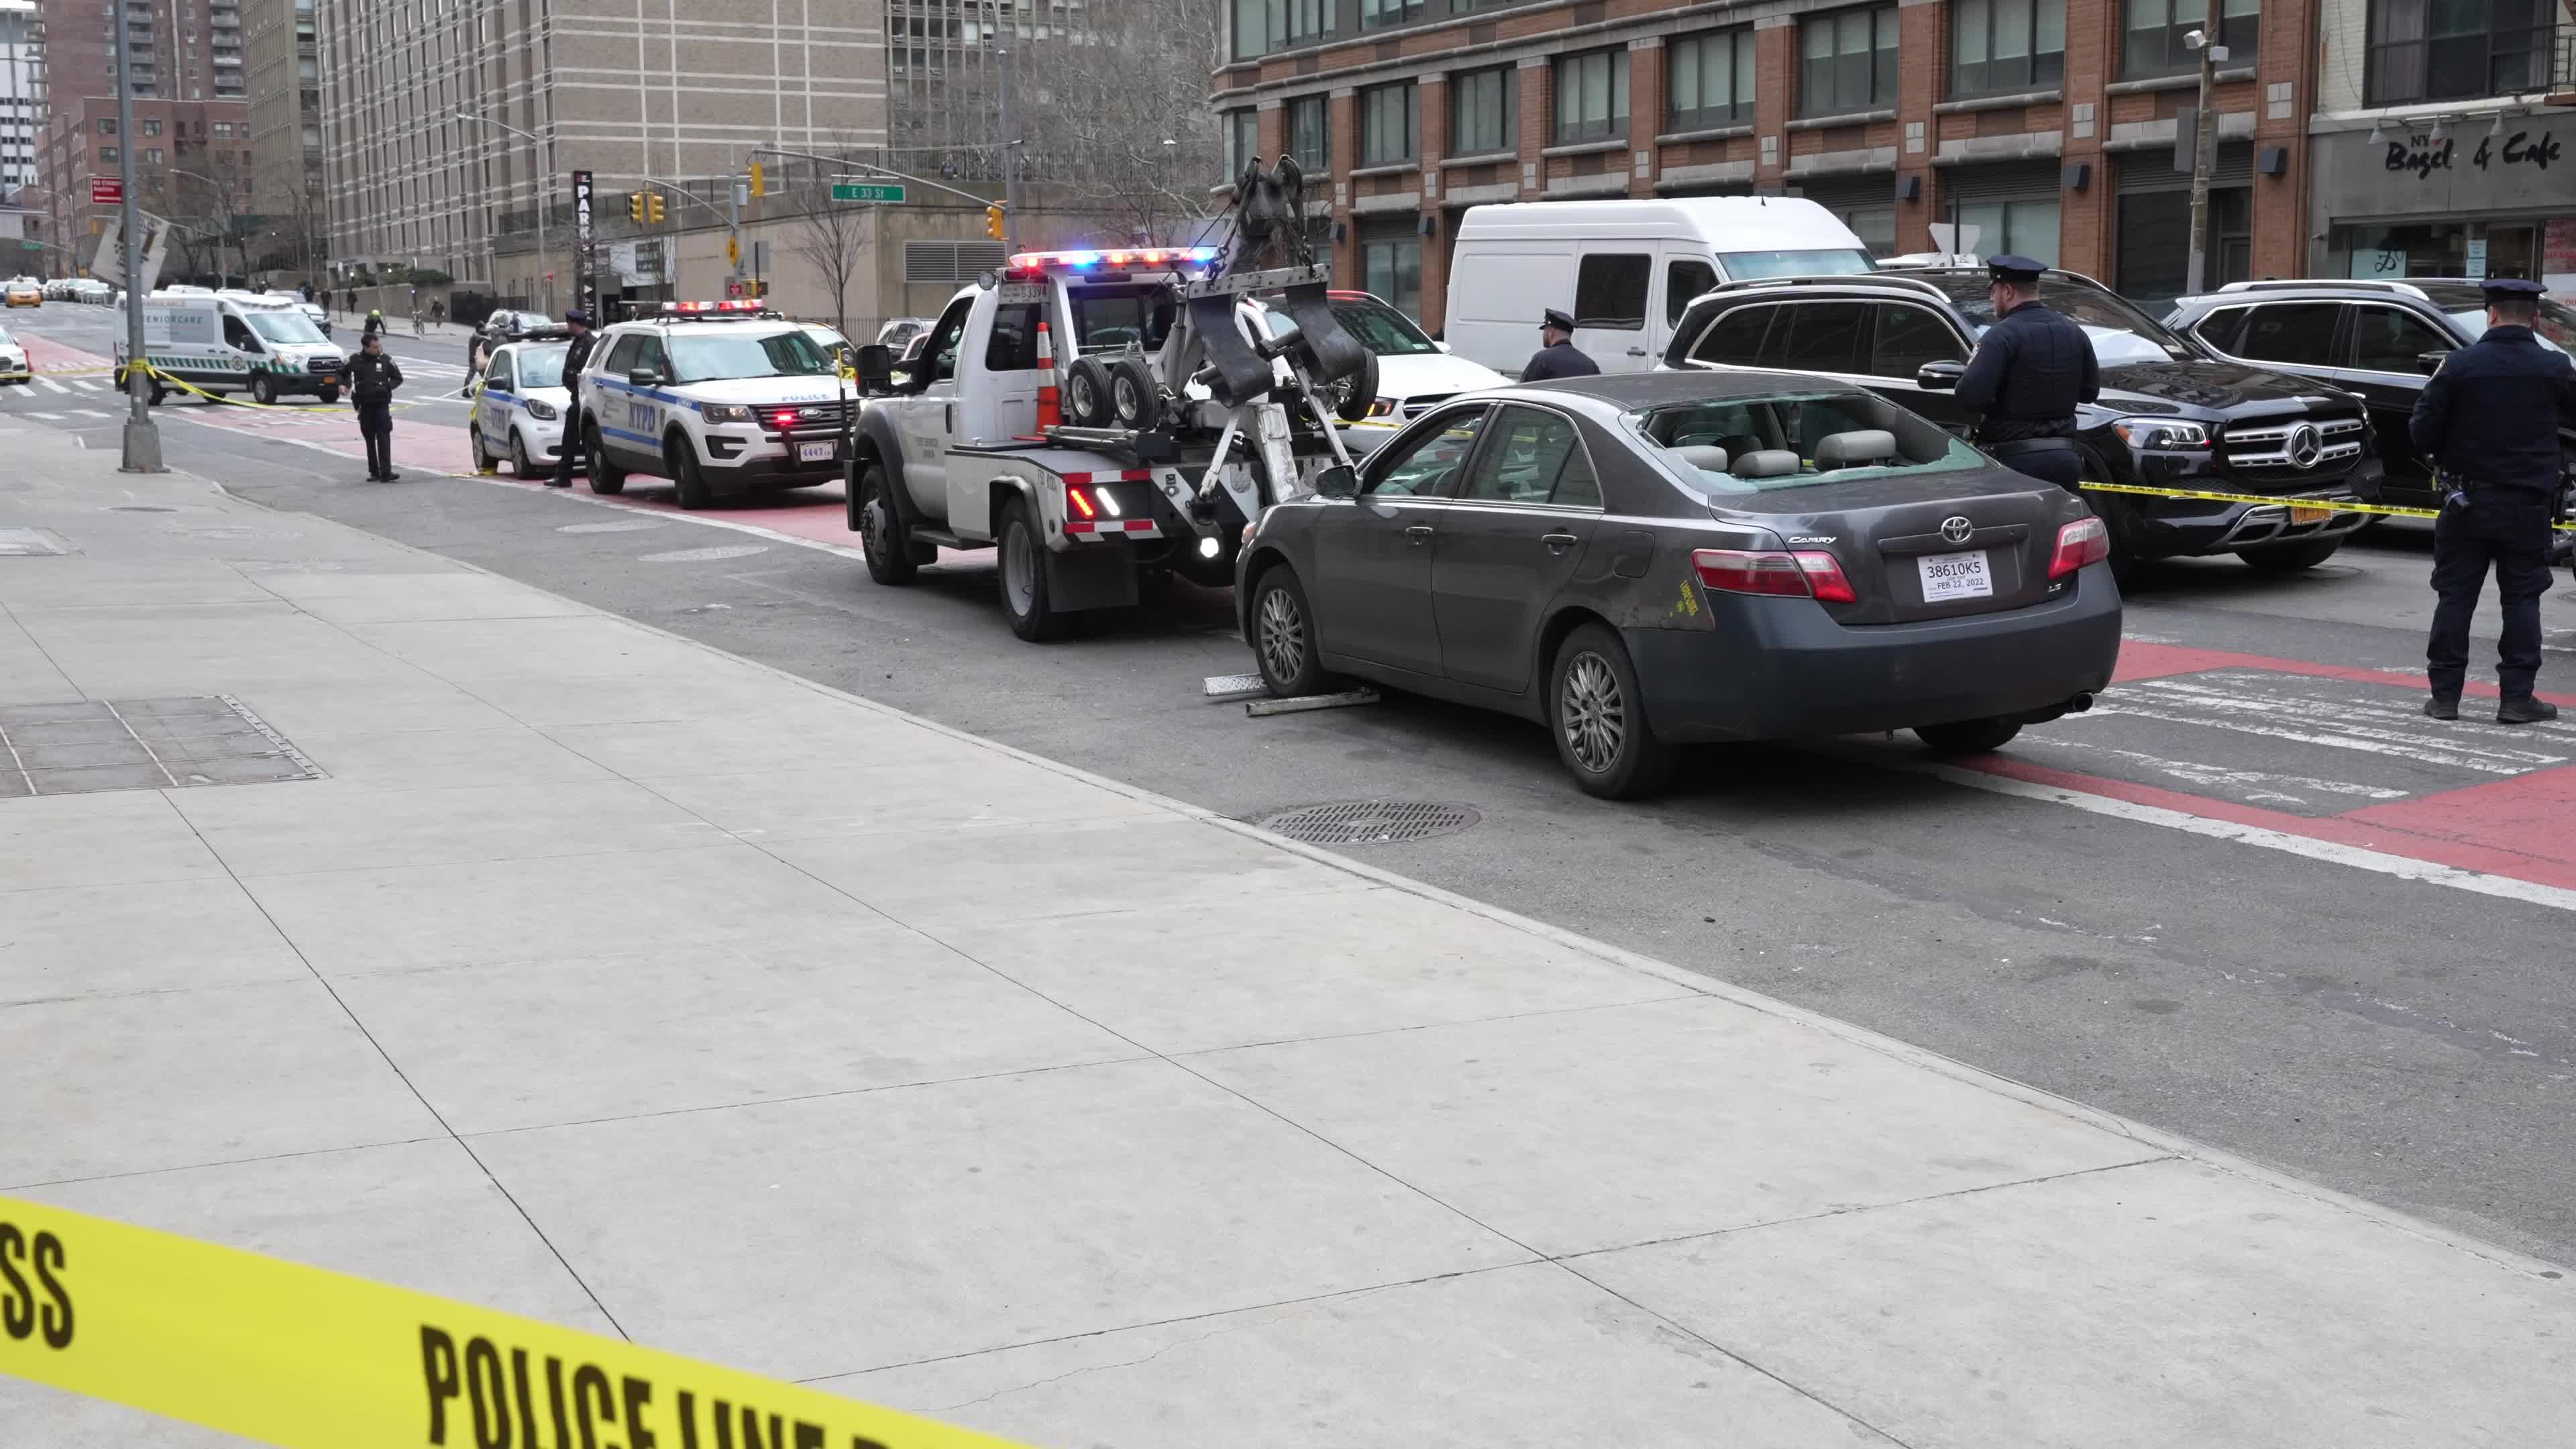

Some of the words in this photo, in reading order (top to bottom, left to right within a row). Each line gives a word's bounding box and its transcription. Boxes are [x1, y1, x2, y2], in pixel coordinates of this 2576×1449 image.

[2411, 135, 2430, 147] NY
[2385, 138, 2453, 180] Bagel
[2503, 131, 2560, 170] Cafe
[852, 187, 858, 198] E
[861, 187, 872, 199] 33
[875, 188, 884, 199] St
[577, 185, 591, 239] PARK
[143, 315, 203, 324] ENIORCARE
[629, 402, 655, 432] NYPD
[1788, 536, 1837, 545] CAMRY
[1927, 561, 1982, 579] 38610K5
[1937, 582, 1951, 590] FEB
[1953, 580, 1965, 588] 22,
[1966, 578, 1984, 587] 2022
[419, 1323, 657, 1449] POLICE
